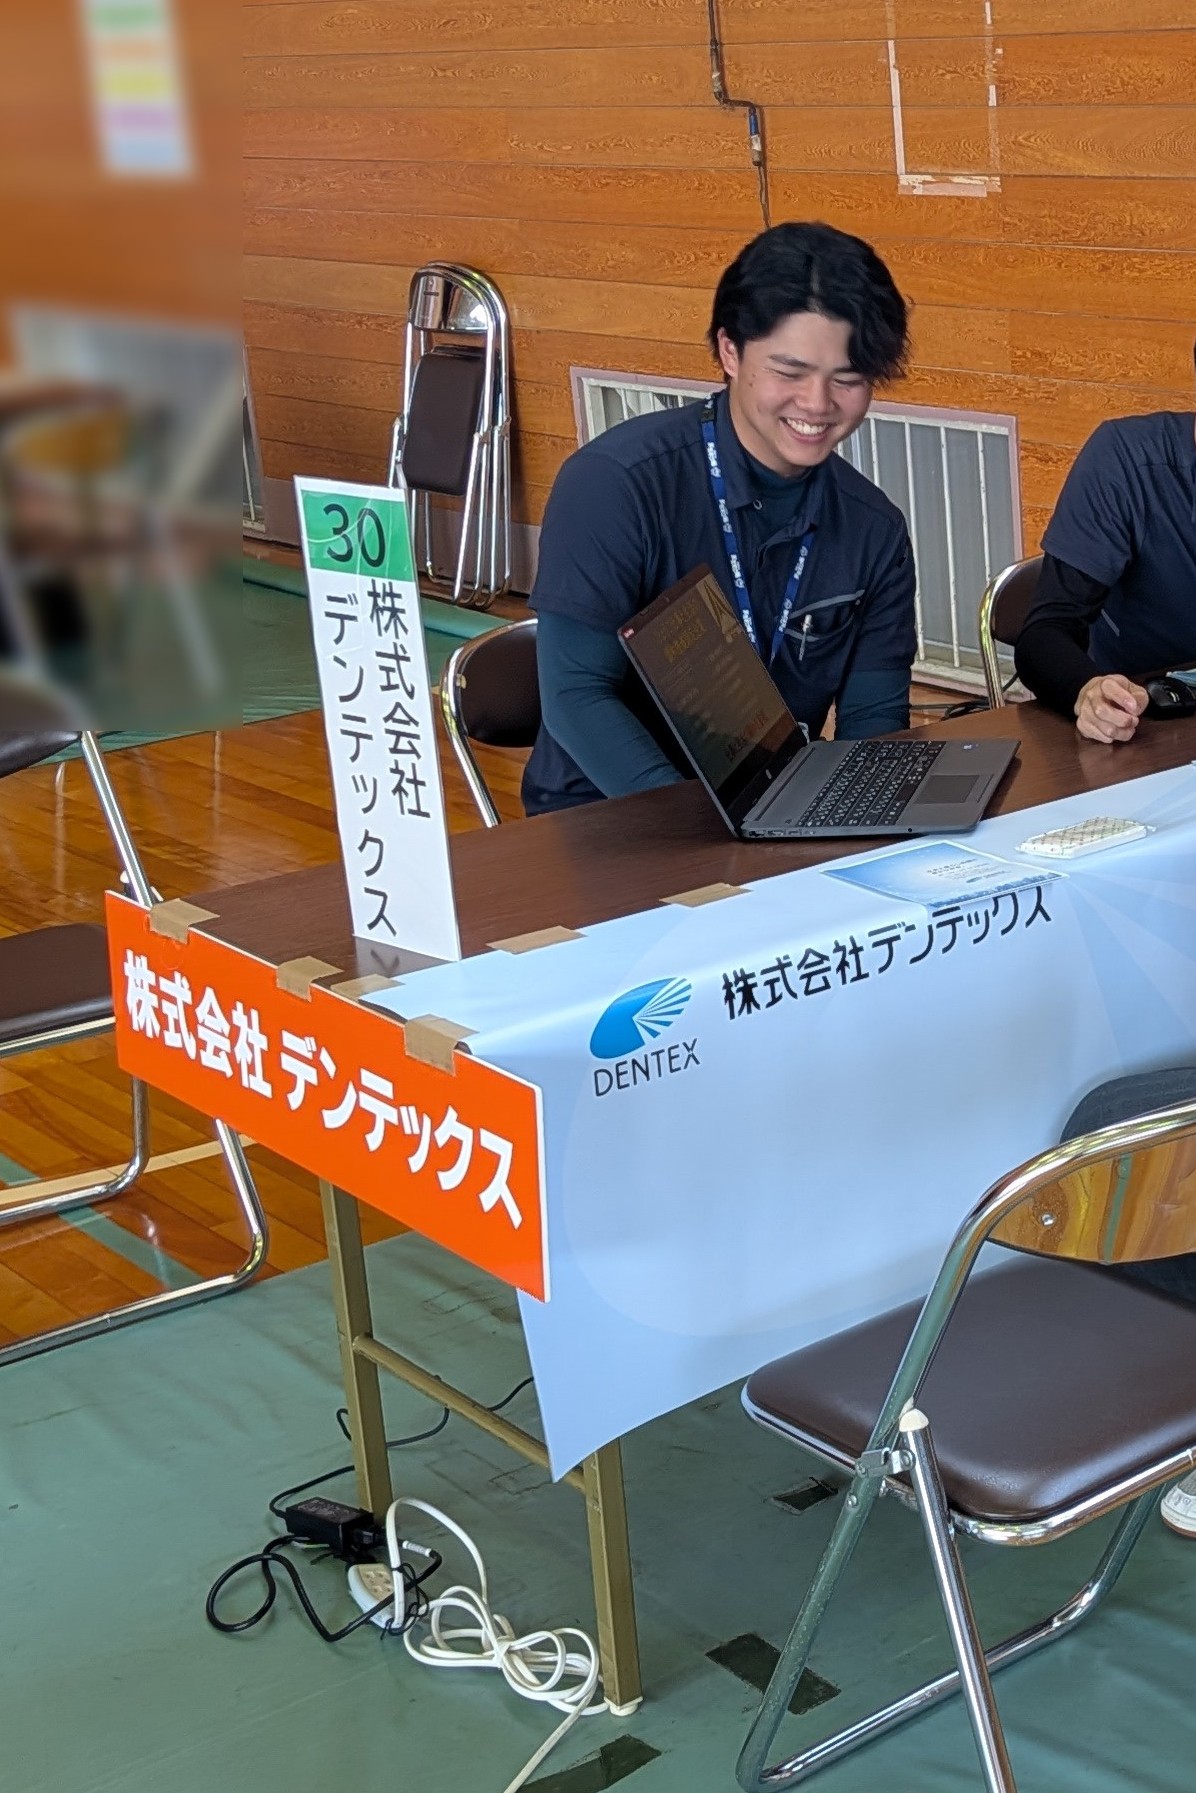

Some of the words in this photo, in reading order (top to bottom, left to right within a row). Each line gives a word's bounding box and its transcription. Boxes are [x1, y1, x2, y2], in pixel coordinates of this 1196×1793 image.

[323, 503, 386, 567] 30
[323, 594, 397, 936] デンテックス
[367, 580, 431, 818] 株式会社
[722, 886, 1053, 1020] 株式会社デンテックス
[593, 1038, 701, 1097] DENTEX
